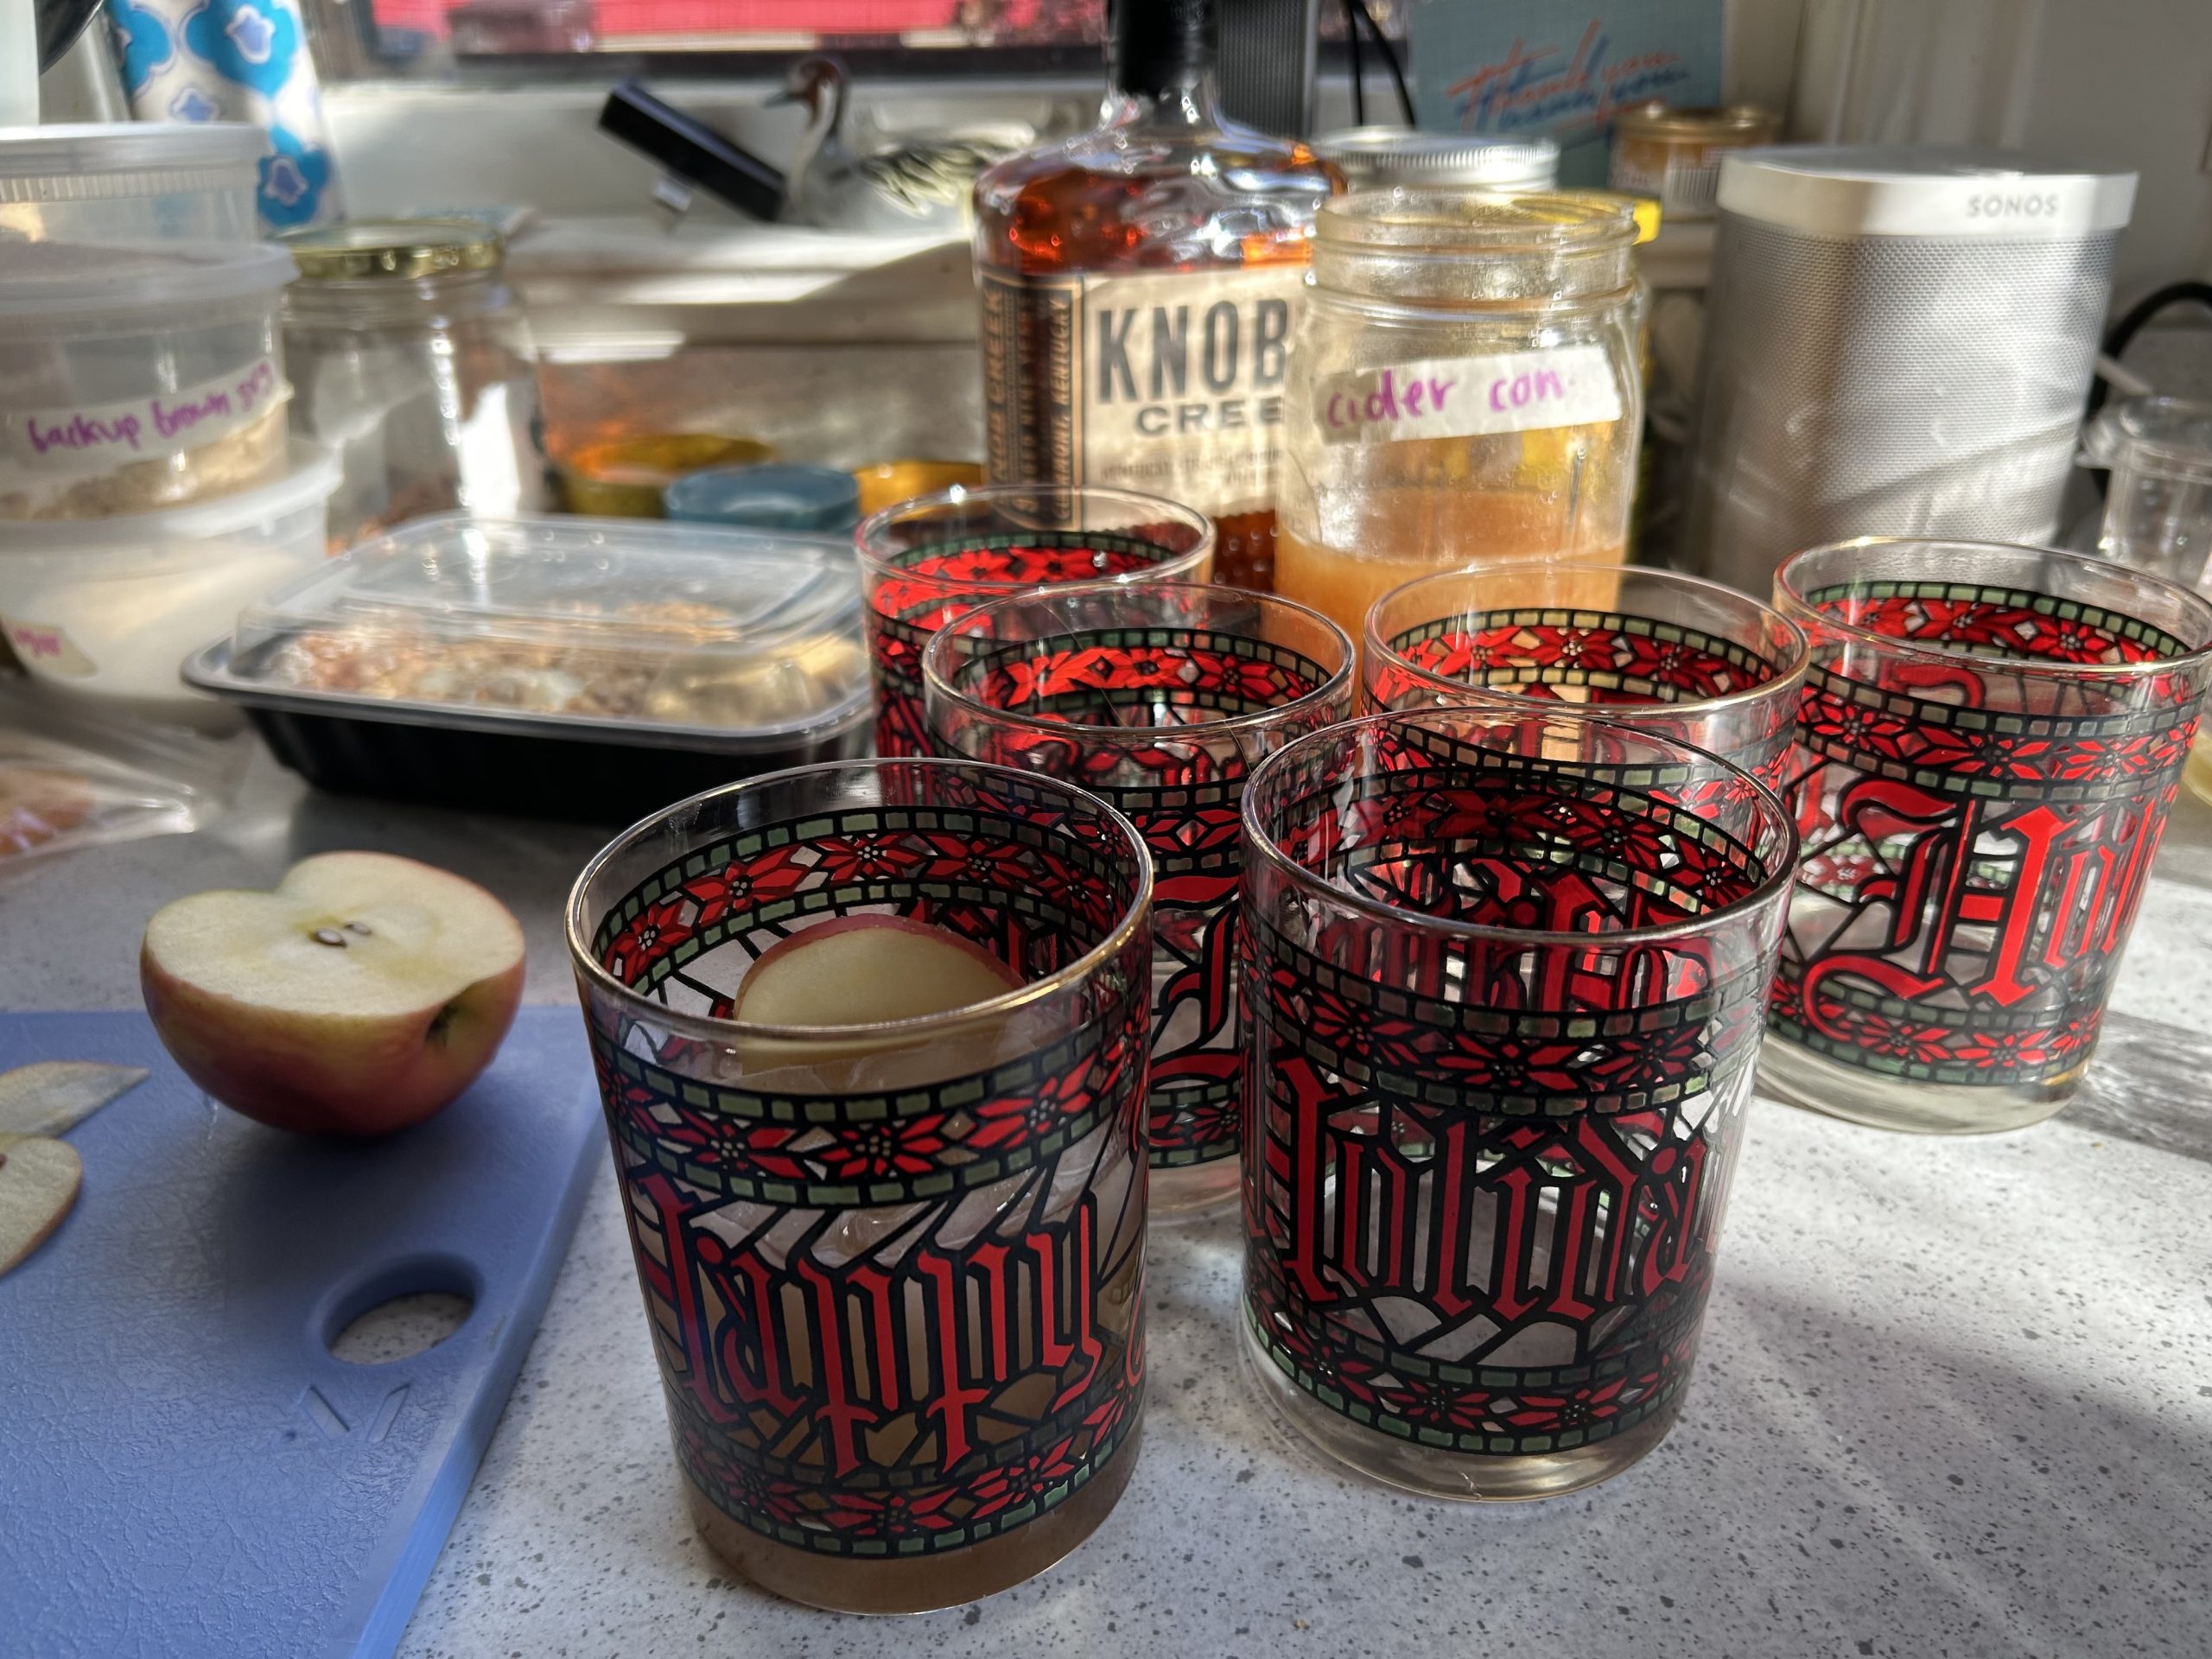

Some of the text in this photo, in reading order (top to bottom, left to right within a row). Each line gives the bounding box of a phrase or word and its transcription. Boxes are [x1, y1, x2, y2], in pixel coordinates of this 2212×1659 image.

[1967, 193, 2059, 218] SONOS
[1098, 299, 1288, 405] KNOB
[1135, 396, 1283, 436] CREE
[1326, 369, 1454, 429] cider
